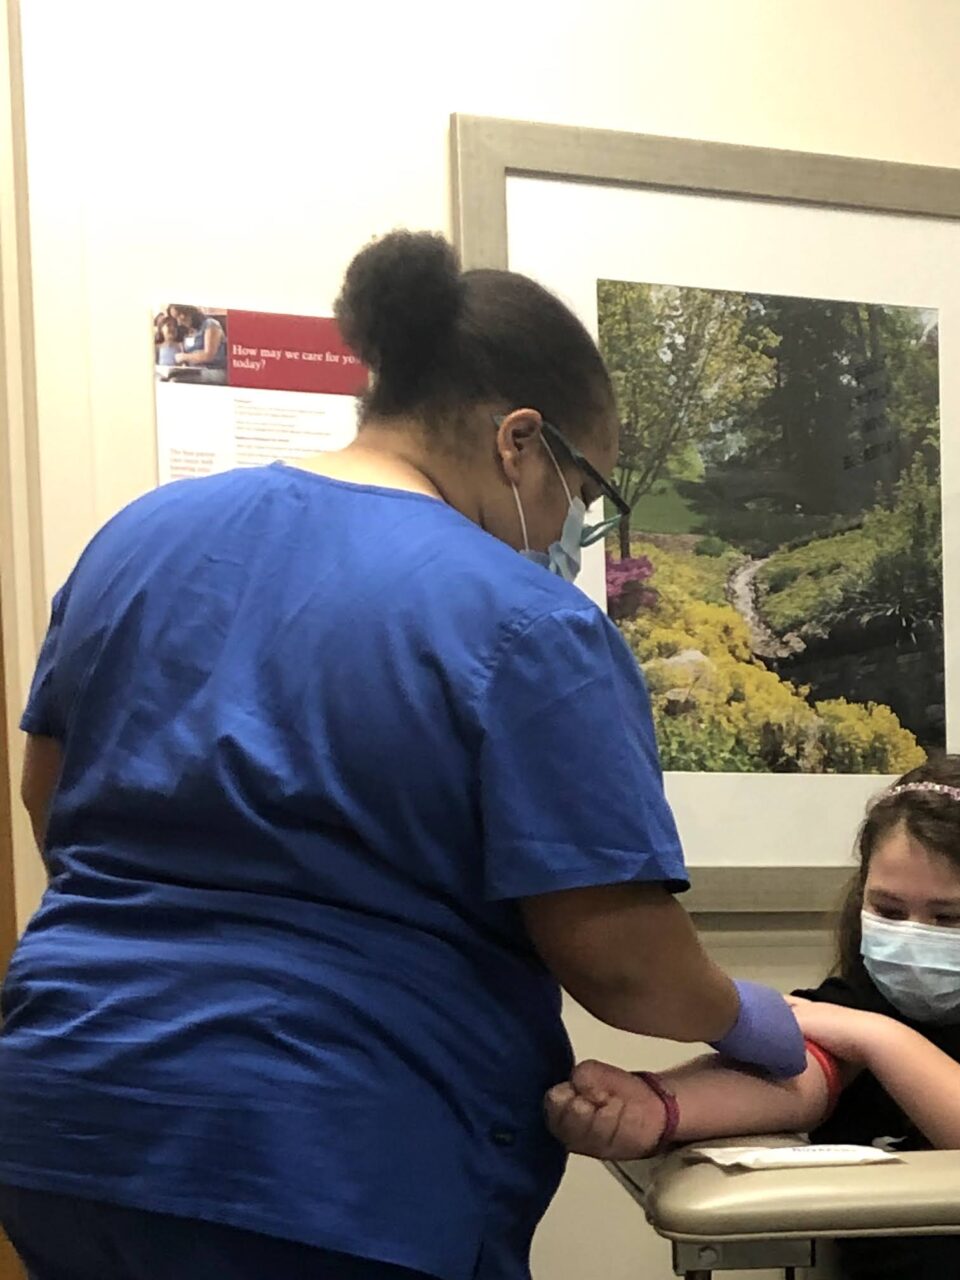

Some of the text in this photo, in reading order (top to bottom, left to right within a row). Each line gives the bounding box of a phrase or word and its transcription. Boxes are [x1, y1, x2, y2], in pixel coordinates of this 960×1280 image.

[232, 344, 257, 356] How
[260, 349, 281, 360] may
[285, 350, 300, 360] we
[301, 351, 323, 361] care
[325, 350, 340, 363] for
[232, 358, 266, 371] today?
